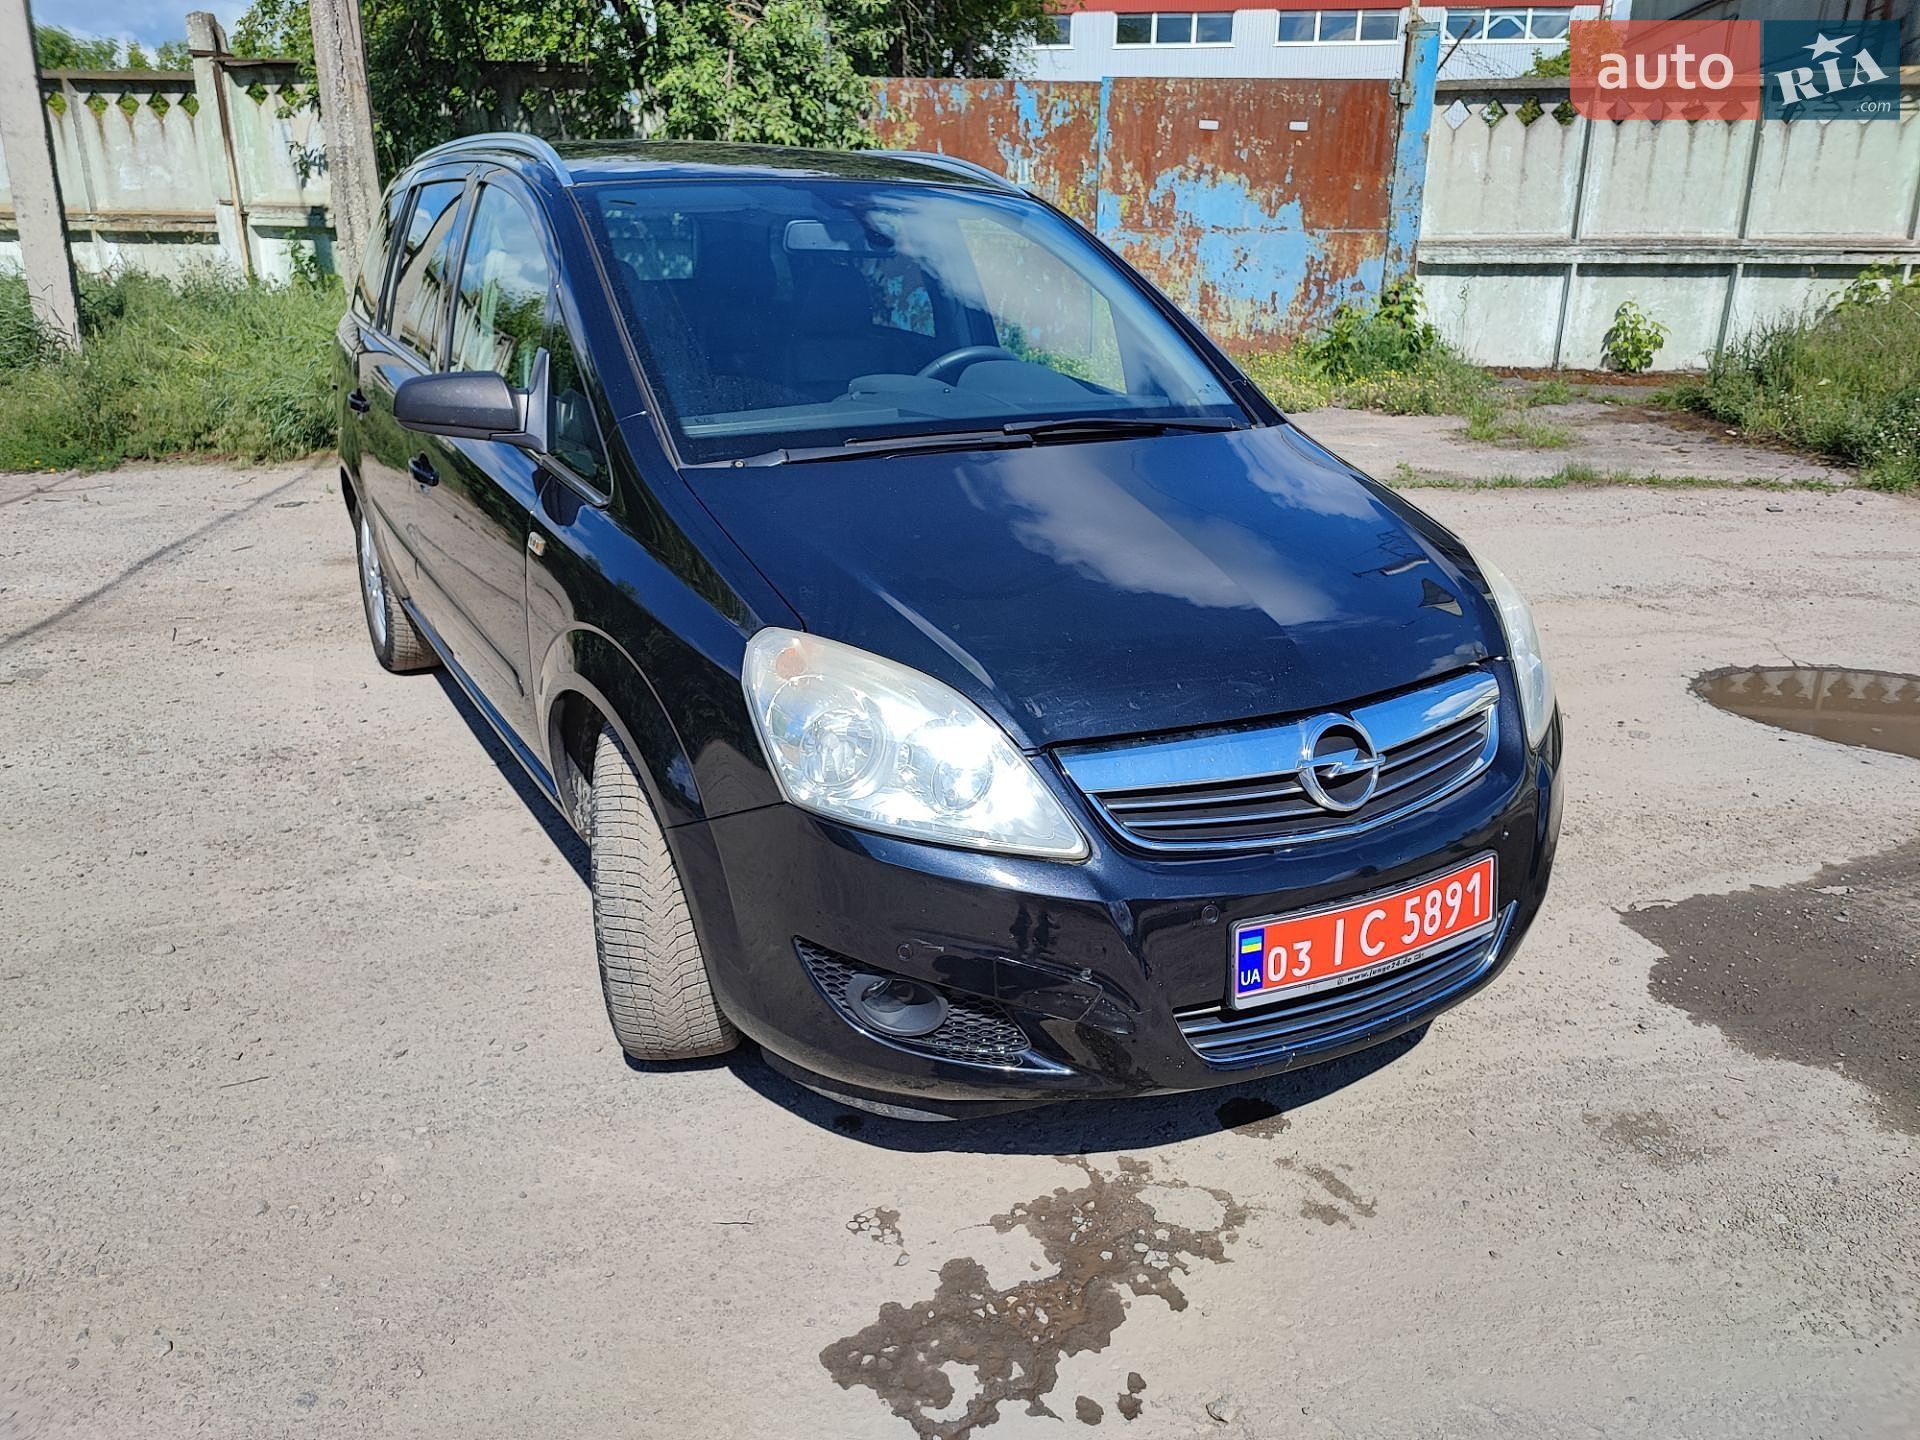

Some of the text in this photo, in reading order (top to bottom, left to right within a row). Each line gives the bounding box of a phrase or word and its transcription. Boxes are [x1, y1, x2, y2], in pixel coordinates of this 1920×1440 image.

[1267, 940, 1312, 982] 03
[1400, 871, 1481, 945] 5891
[1241, 968, 1261, 986] UA
